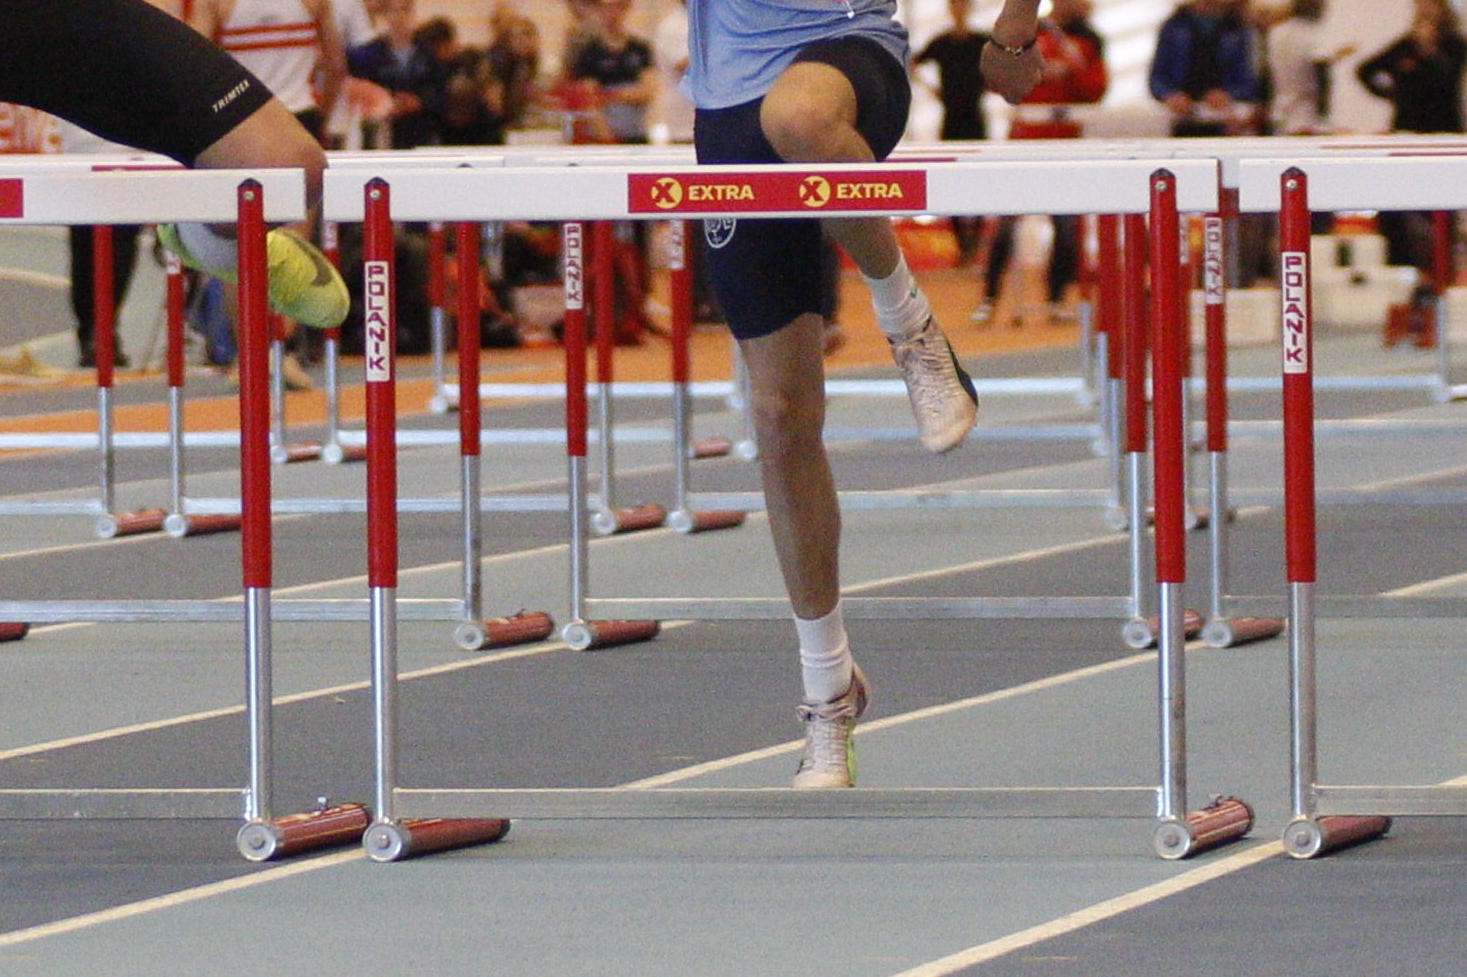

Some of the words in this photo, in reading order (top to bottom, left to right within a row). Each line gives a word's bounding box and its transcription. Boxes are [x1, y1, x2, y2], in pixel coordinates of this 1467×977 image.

[688, 184, 755, 201] EXTRA
[836, 182, 903, 199] EXTRA
[566, 225, 582, 302] POLANIK
[1206, 219, 1222, 297] POLANIK
[367, 264, 387, 371] POLANIK
[1284, 255, 1306, 363] POLANIK
